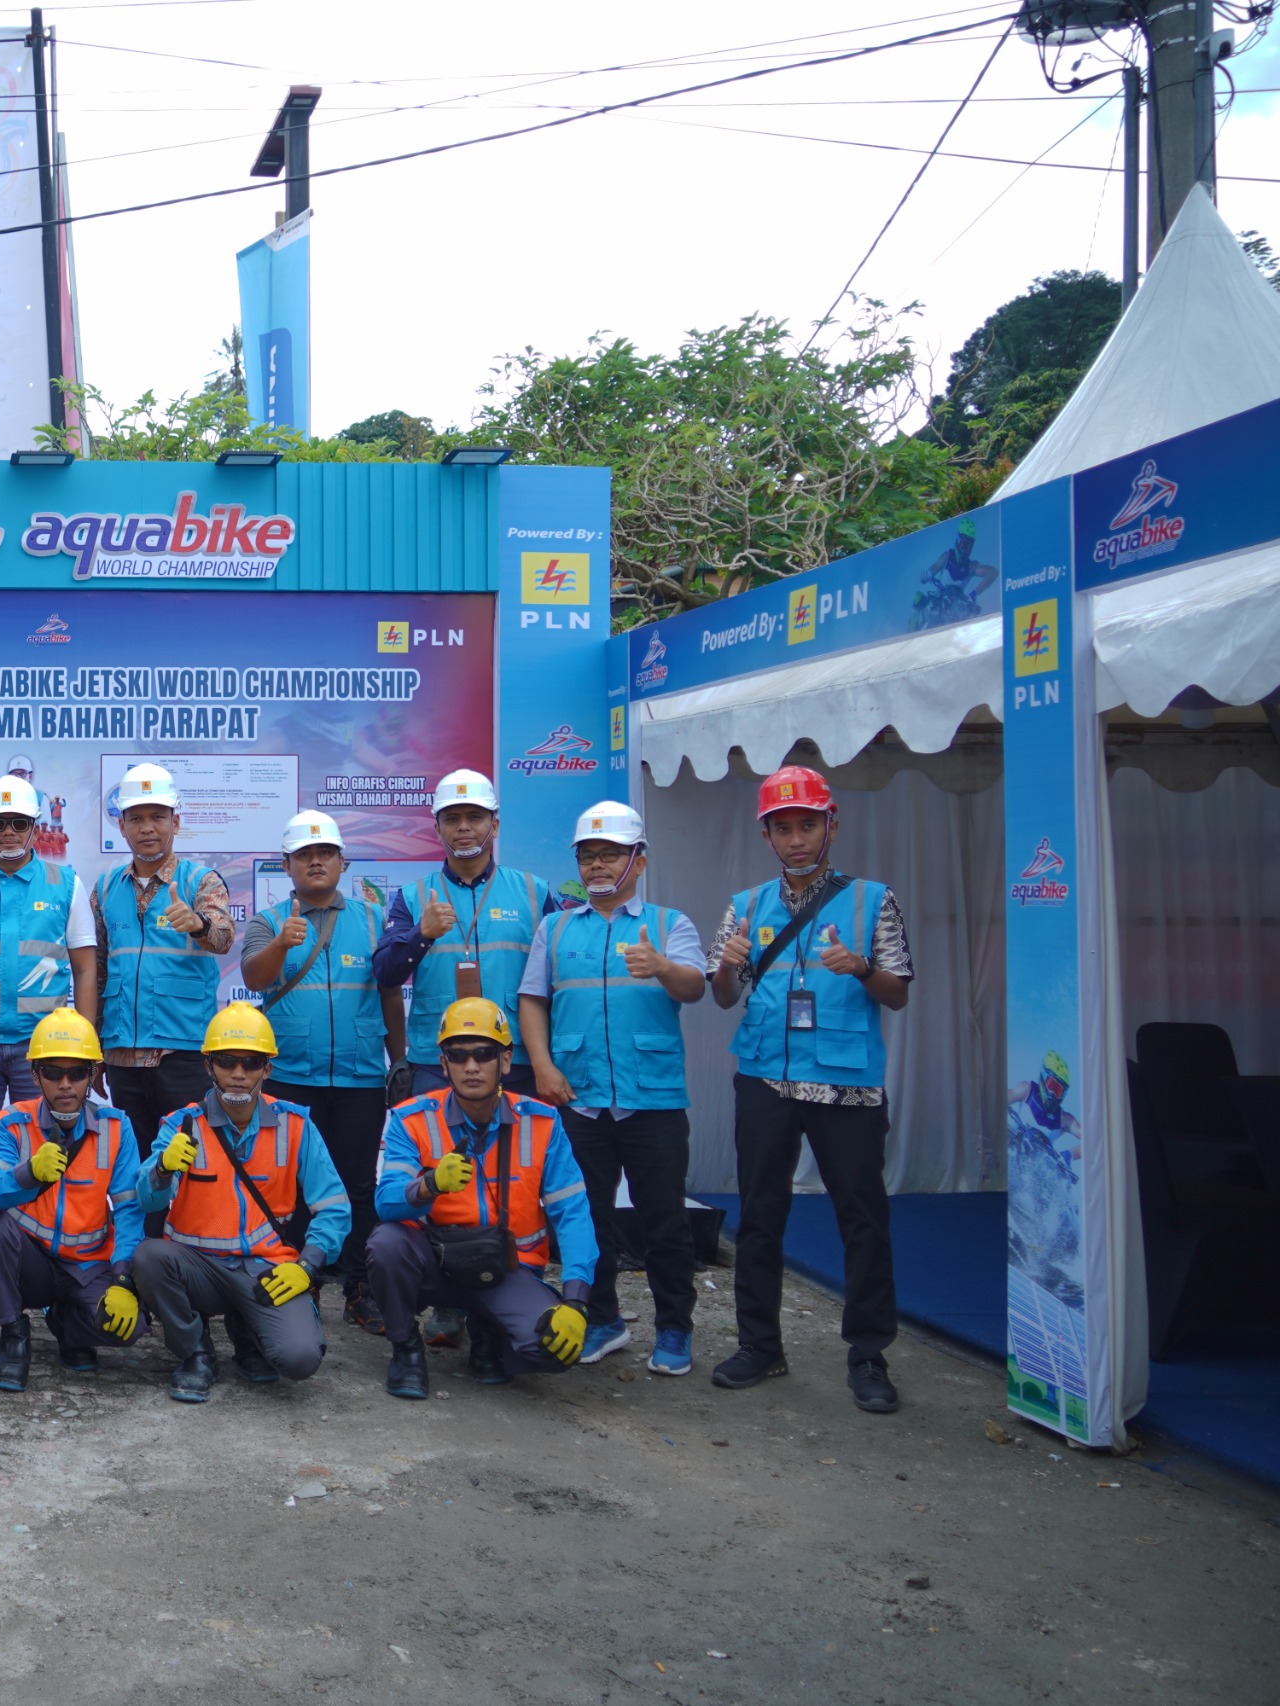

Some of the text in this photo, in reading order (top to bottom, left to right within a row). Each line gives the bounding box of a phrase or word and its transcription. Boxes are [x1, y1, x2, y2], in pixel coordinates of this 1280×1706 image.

[24, 492, 293, 580] aquabike
[507, 527, 568, 540] Powered
[1093, 514, 1184, 570] aquabike
[96, 560, 275, 578] WORLD CHAMPIONSHIP
[1005, 569, 1046, 592] Powered
[821, 582, 869, 624] PLN
[521, 611, 590, 630] PLN
[27, 631, 71, 646] aquabike
[413, 628, 464, 647] PLN
[701, 617, 756, 654] Powered
[72, 668, 150, 699] JETSKI
[157, 668, 238, 699] WORLD
[245, 669, 419, 700] CHAMPIONSHIP
[1014, 680, 1060, 710] PLN
[41, 706, 135, 740] BAHARI
[142, 707, 260, 740] PARAPAT
[508, 754, 598, 776] aquabike
[610, 755, 626, 771] PLN
[326, 776, 426, 790] INFO GRAFIS CIRCUIT
[317, 792, 354, 806] WISMA
[354, 792, 392, 806] BAHARI
[1011, 877, 1068, 908] aquabike
[44, 903, 61, 911] PLN
[502, 909, 519, 917] PLN
[231, 986, 265, 1001] LOKAS
